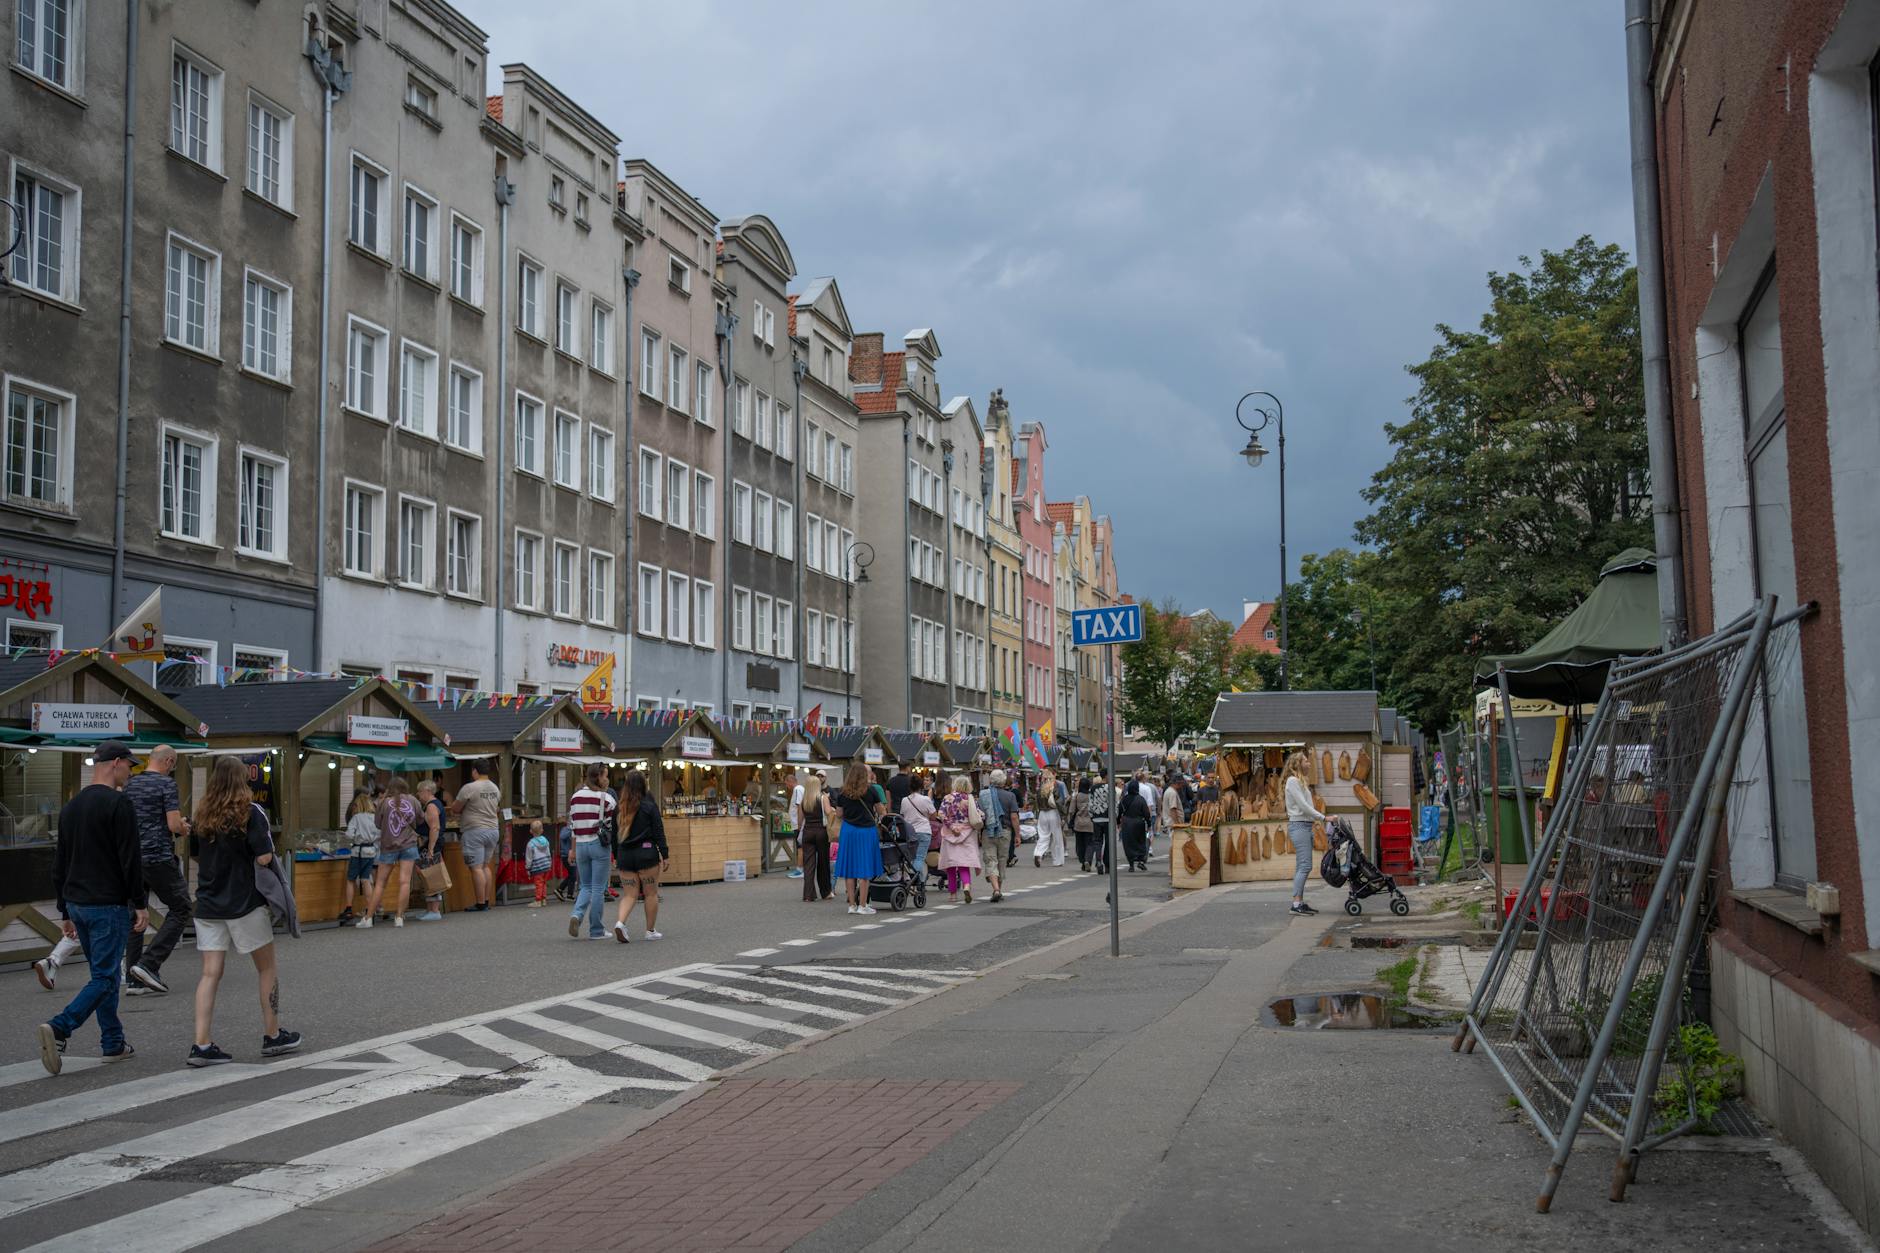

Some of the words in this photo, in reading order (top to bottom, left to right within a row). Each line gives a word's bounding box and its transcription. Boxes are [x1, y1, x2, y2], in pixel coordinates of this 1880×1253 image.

[1075, 610, 1135, 640] TAXI
[52, 710, 84, 720] CHAŁWA
[86, 711, 118, 720] TURECKA
[83, 720, 110, 729] HARIBO
